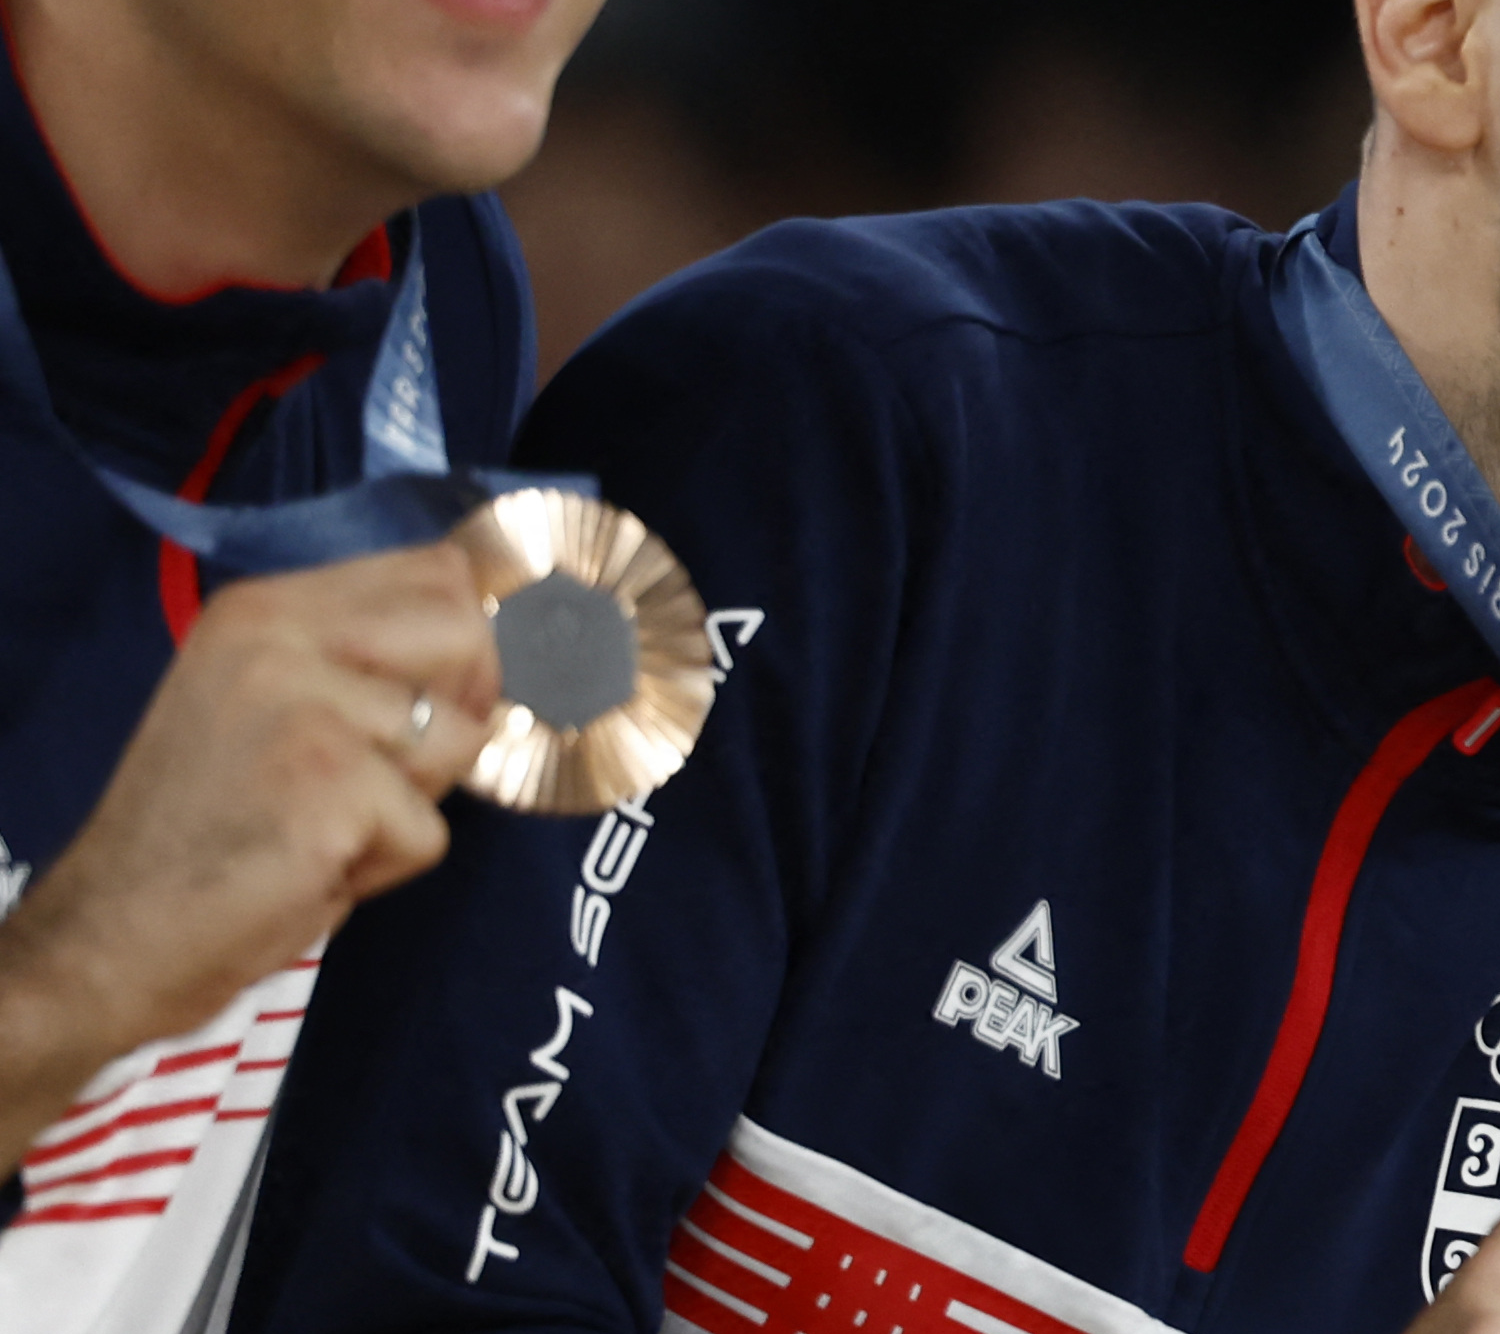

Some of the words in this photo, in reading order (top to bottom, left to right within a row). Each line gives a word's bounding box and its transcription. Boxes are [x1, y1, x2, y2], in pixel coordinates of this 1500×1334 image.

[1388, 426, 1467, 546] 2024
[932, 958, 1081, 1080] PEAK
[466, 984, 594, 1283] TEAM
